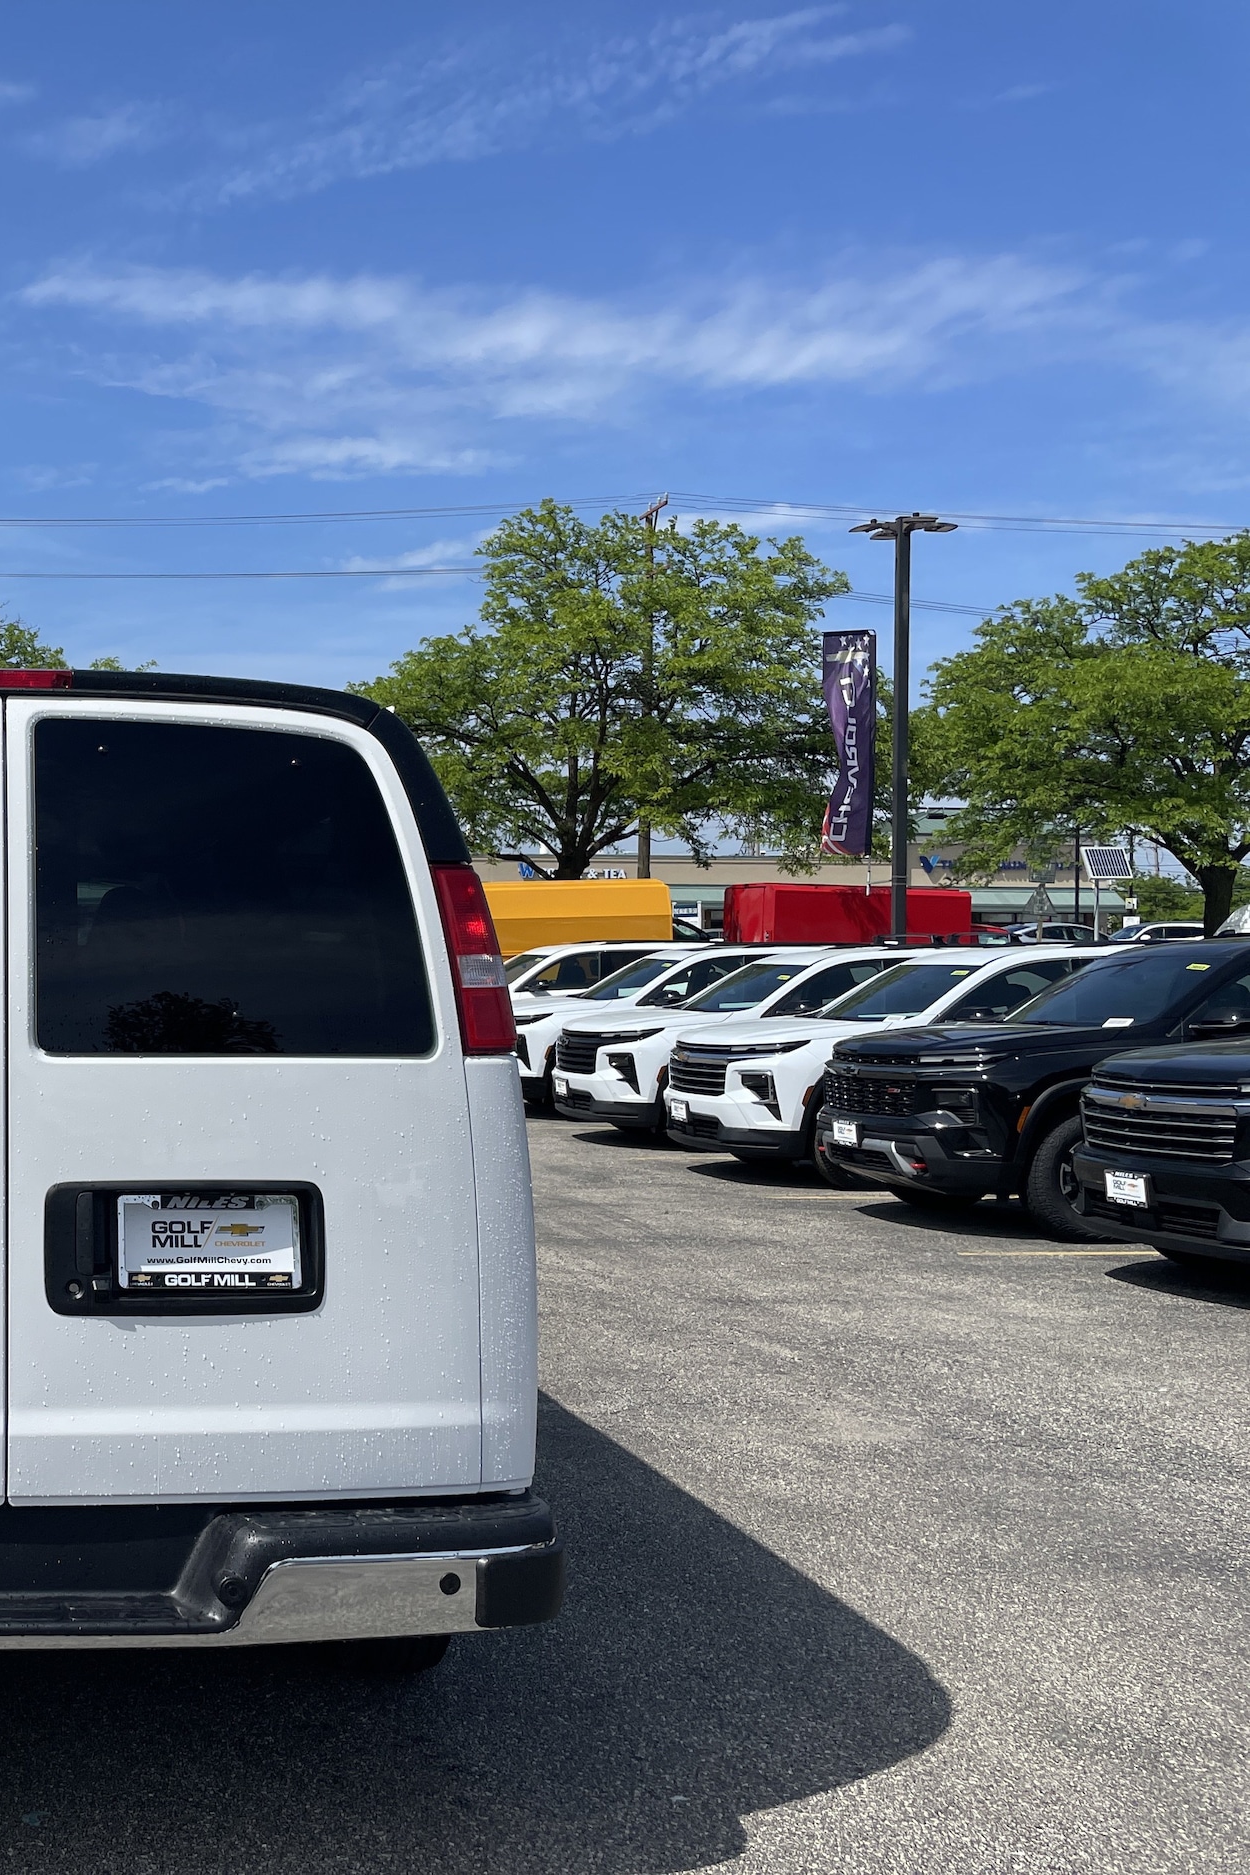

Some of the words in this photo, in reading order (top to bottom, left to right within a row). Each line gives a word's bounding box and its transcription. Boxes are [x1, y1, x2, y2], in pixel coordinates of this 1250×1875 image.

[603, 868, 627, 879] TEA
[166, 1195, 250, 1209] NILES
[151, 1220, 214, 1234] GOLF
[152, 1234, 203, 1248] MILL
[146, 1256, 272, 1266] www.GolfMillChevy.com
[164, 1273, 212, 1287] GOLF
[213, 1273, 257, 1287] MILL
